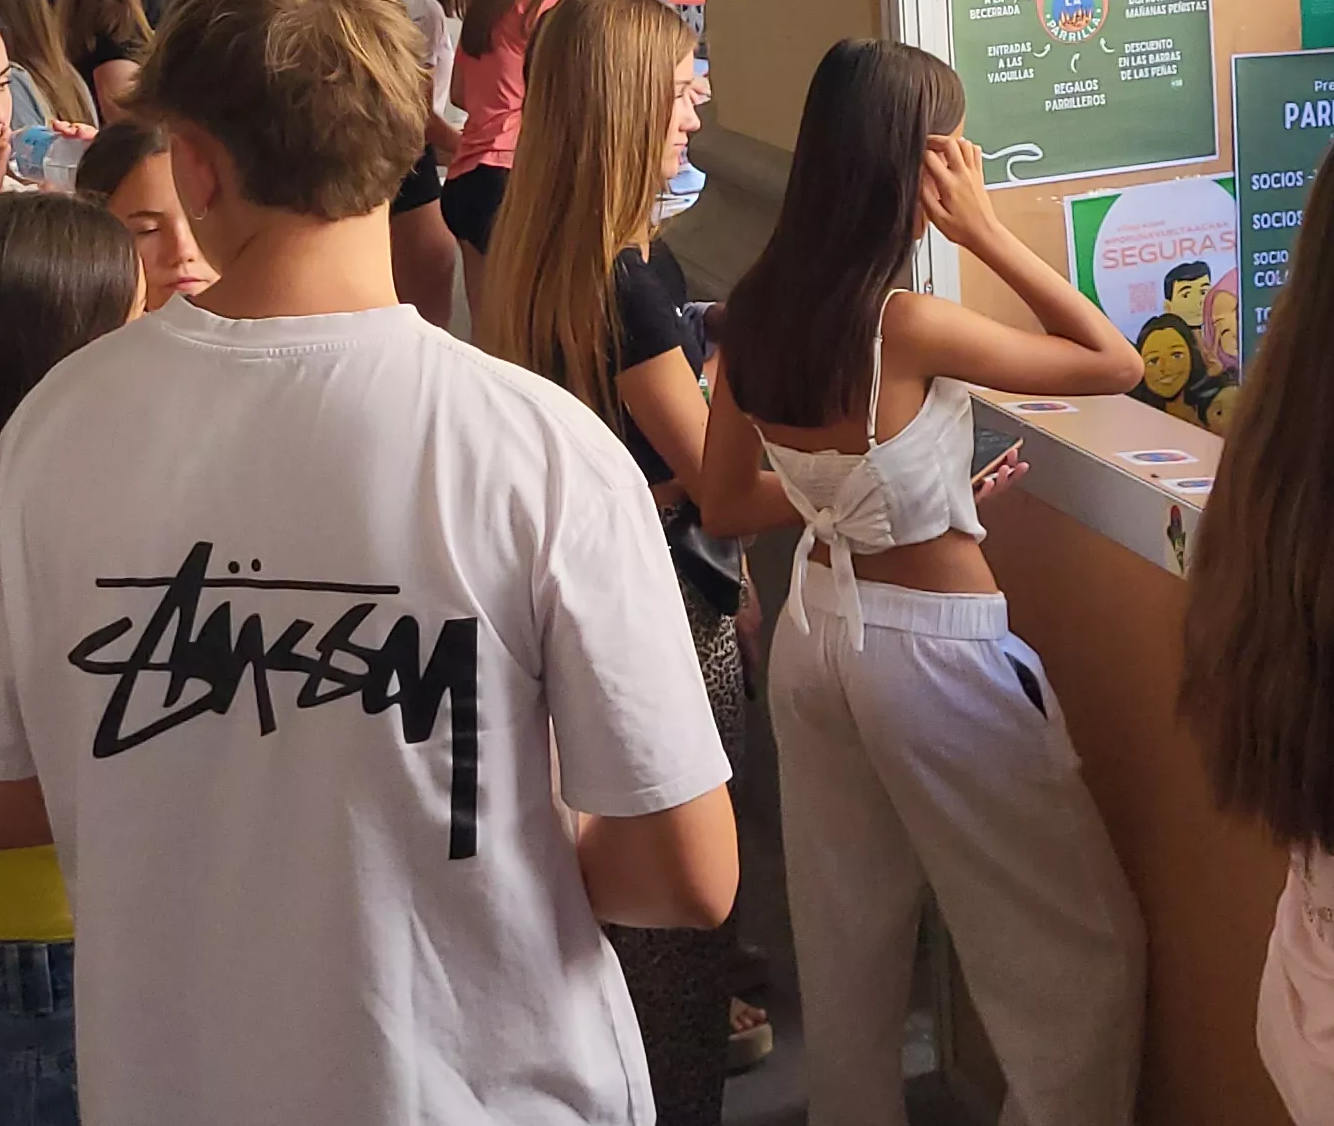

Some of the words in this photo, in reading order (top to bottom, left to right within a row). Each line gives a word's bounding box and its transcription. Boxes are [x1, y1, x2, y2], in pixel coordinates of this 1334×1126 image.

[969, 4, 1020, 20] BECERRADA
[1125, 5, 1167, 19] MAÑANAS
[1168, 0, 1207, 15] PEÑISTAS
[1046, 17, 1101, 43] PARRILLA
[987, 42, 1032, 57] ENTRADAS
[1124, 39, 1173, 53] DESCUENTO
[998, 58, 1005, 69] A
[1006, 56, 1023, 68] LAS
[1118, 56, 1131, 68] EN
[1131, 54, 1147, 66] LAS
[1148, 50, 1181, 64] BARRAS
[987, 68, 1035, 83] VAQUILLAS
[1120, 69, 1132, 81] DE
[1133, 67, 1149, 80] LAS
[1149, 64, 1177, 78] PEÑAS
[1054, 79, 1099, 96] REGALOS
[1045, 94, 1106, 112] PARRILLEROS
[1251, 170, 1304, 191] SOCIOS
[1103, 230, 1236, 269] SEGURAS
[1253, 250, 1289, 266] SOCIO
